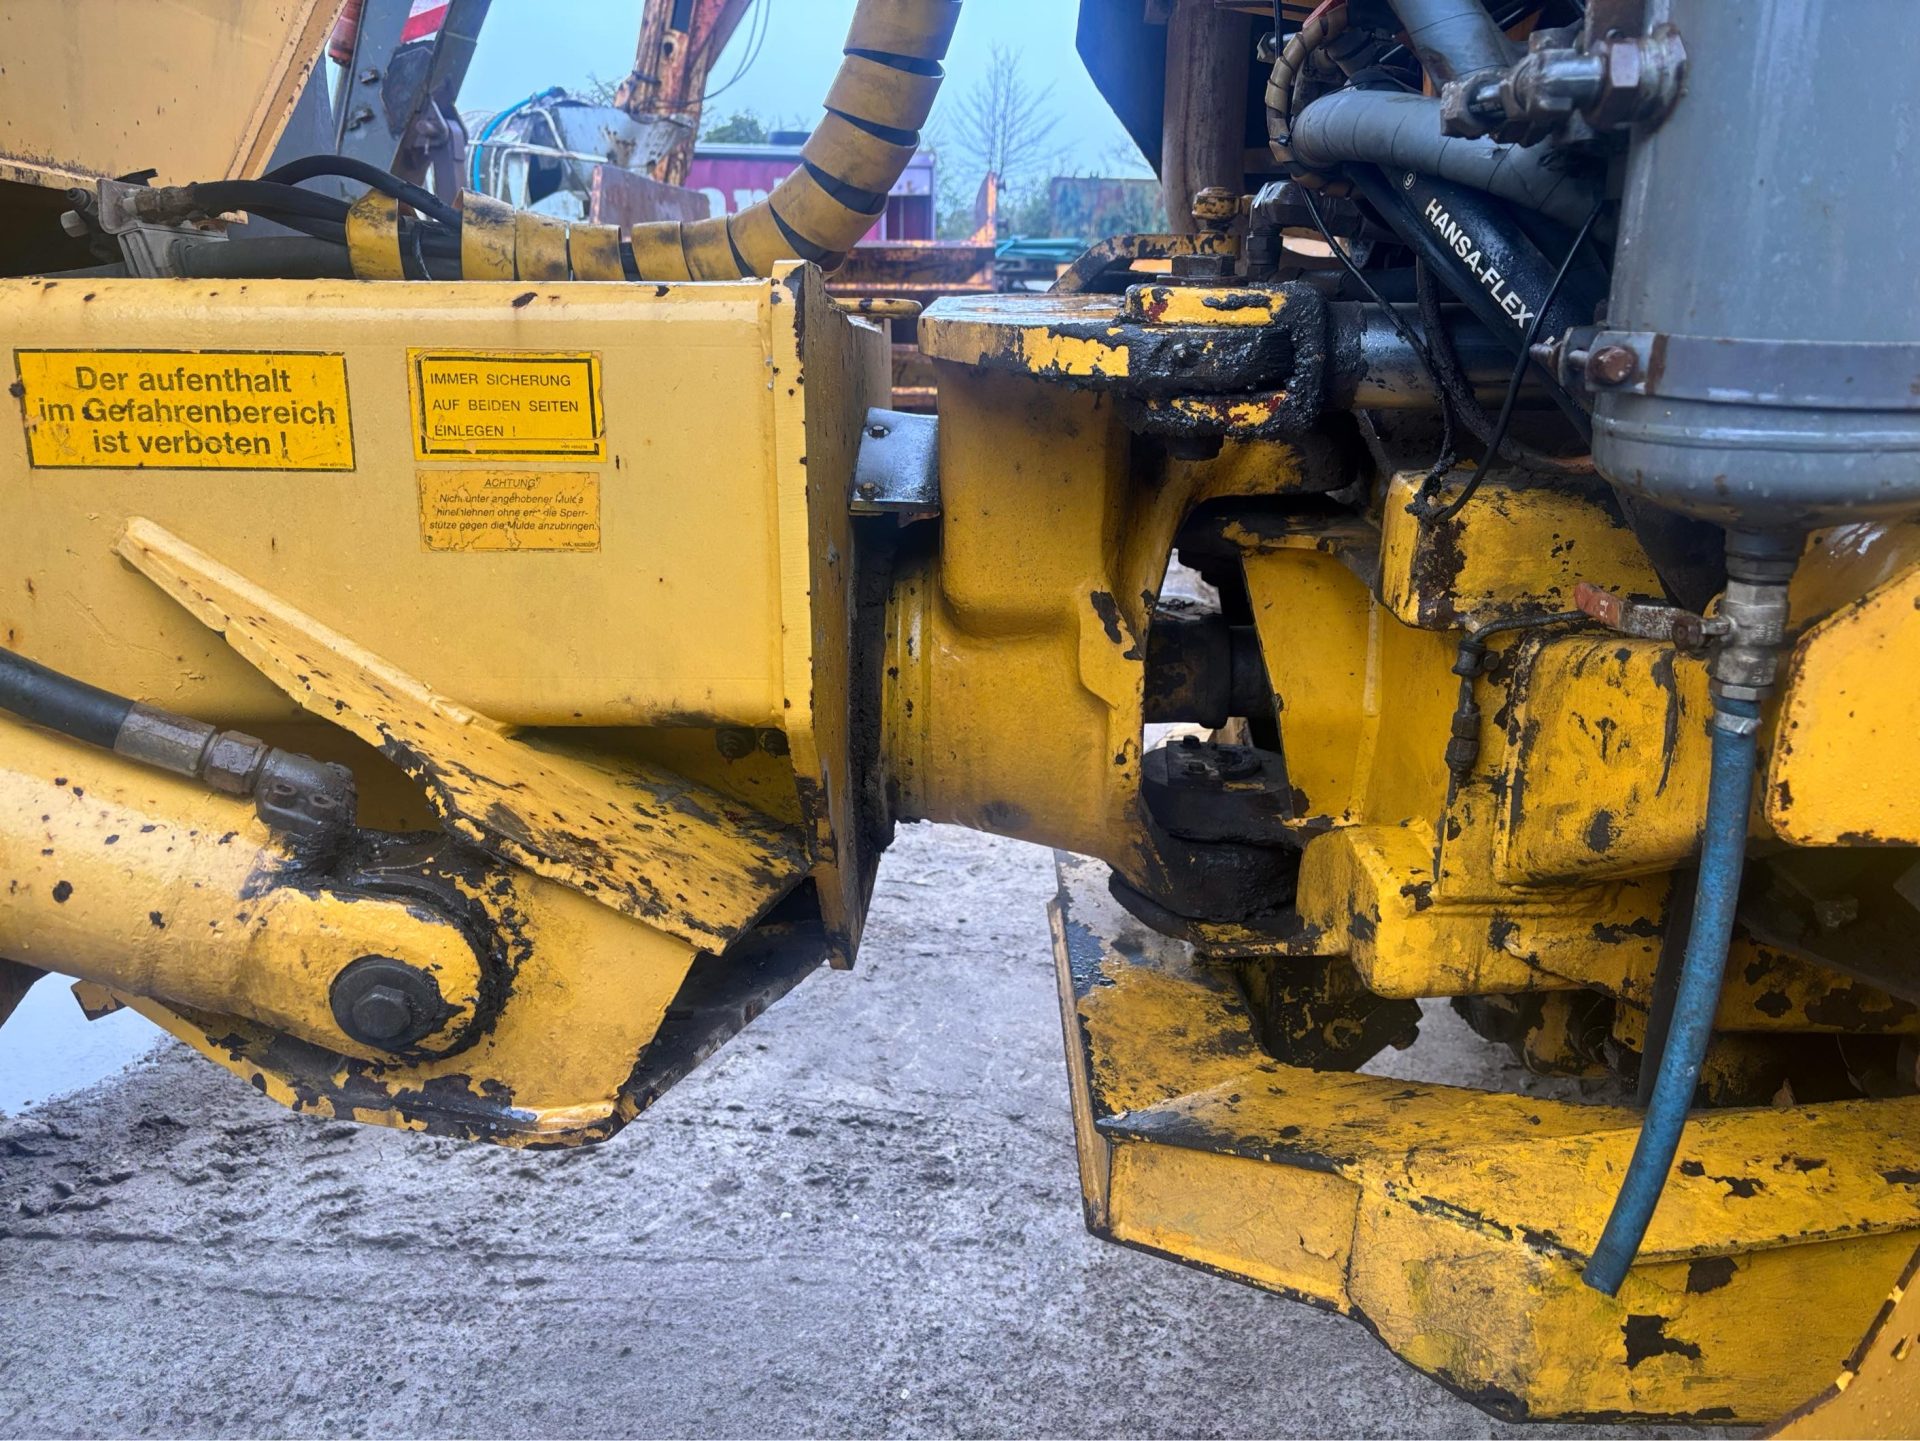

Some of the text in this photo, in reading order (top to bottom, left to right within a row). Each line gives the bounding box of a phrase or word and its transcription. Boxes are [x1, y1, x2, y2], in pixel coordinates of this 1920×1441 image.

[1425, 198, 1534, 328] HANSA-FLEX
[75, 366, 292, 393] Der aufenthalt
[430, 373, 571, 386] IMMER SICHERUNG
[39, 397, 336, 425] im Gefahrenbereich
[432, 400, 579, 412] AUF BEIDEN SEITEN
[434, 425, 516, 437] EINLEGEN !
[93, 429, 287, 455] ist verboten !
[465, 494, 489, 503] unter
[491, 495, 553, 505] angehobener
[497, 509, 521, 517] ohne
[543, 508, 557, 517] die
[560, 509, 589, 519] Sperr-
[429, 520, 597, 532] stütze gegen die Mulde anzubringen.
